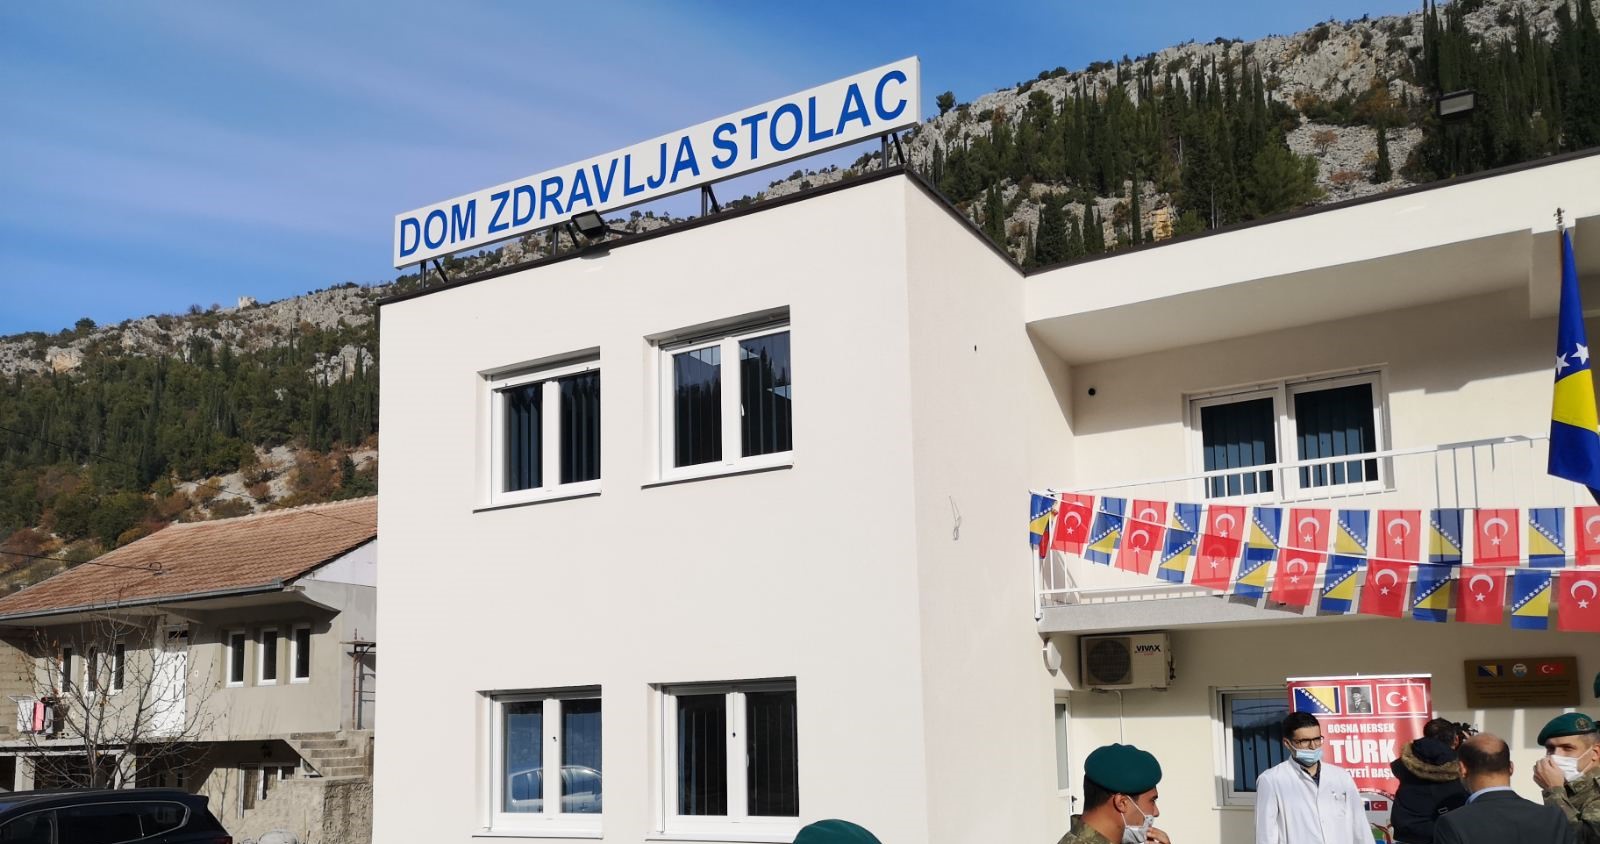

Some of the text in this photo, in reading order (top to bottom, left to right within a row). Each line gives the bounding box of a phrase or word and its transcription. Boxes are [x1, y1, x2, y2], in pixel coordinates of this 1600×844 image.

[399, 70, 908, 258] DOM ZDRAVLJA STOLAC
[1136, 644, 1161, 652] VIVAX
[1327, 723, 1395, 733] BOSNA HERSEK
[1329, 735, 1397, 764] TÜRK
